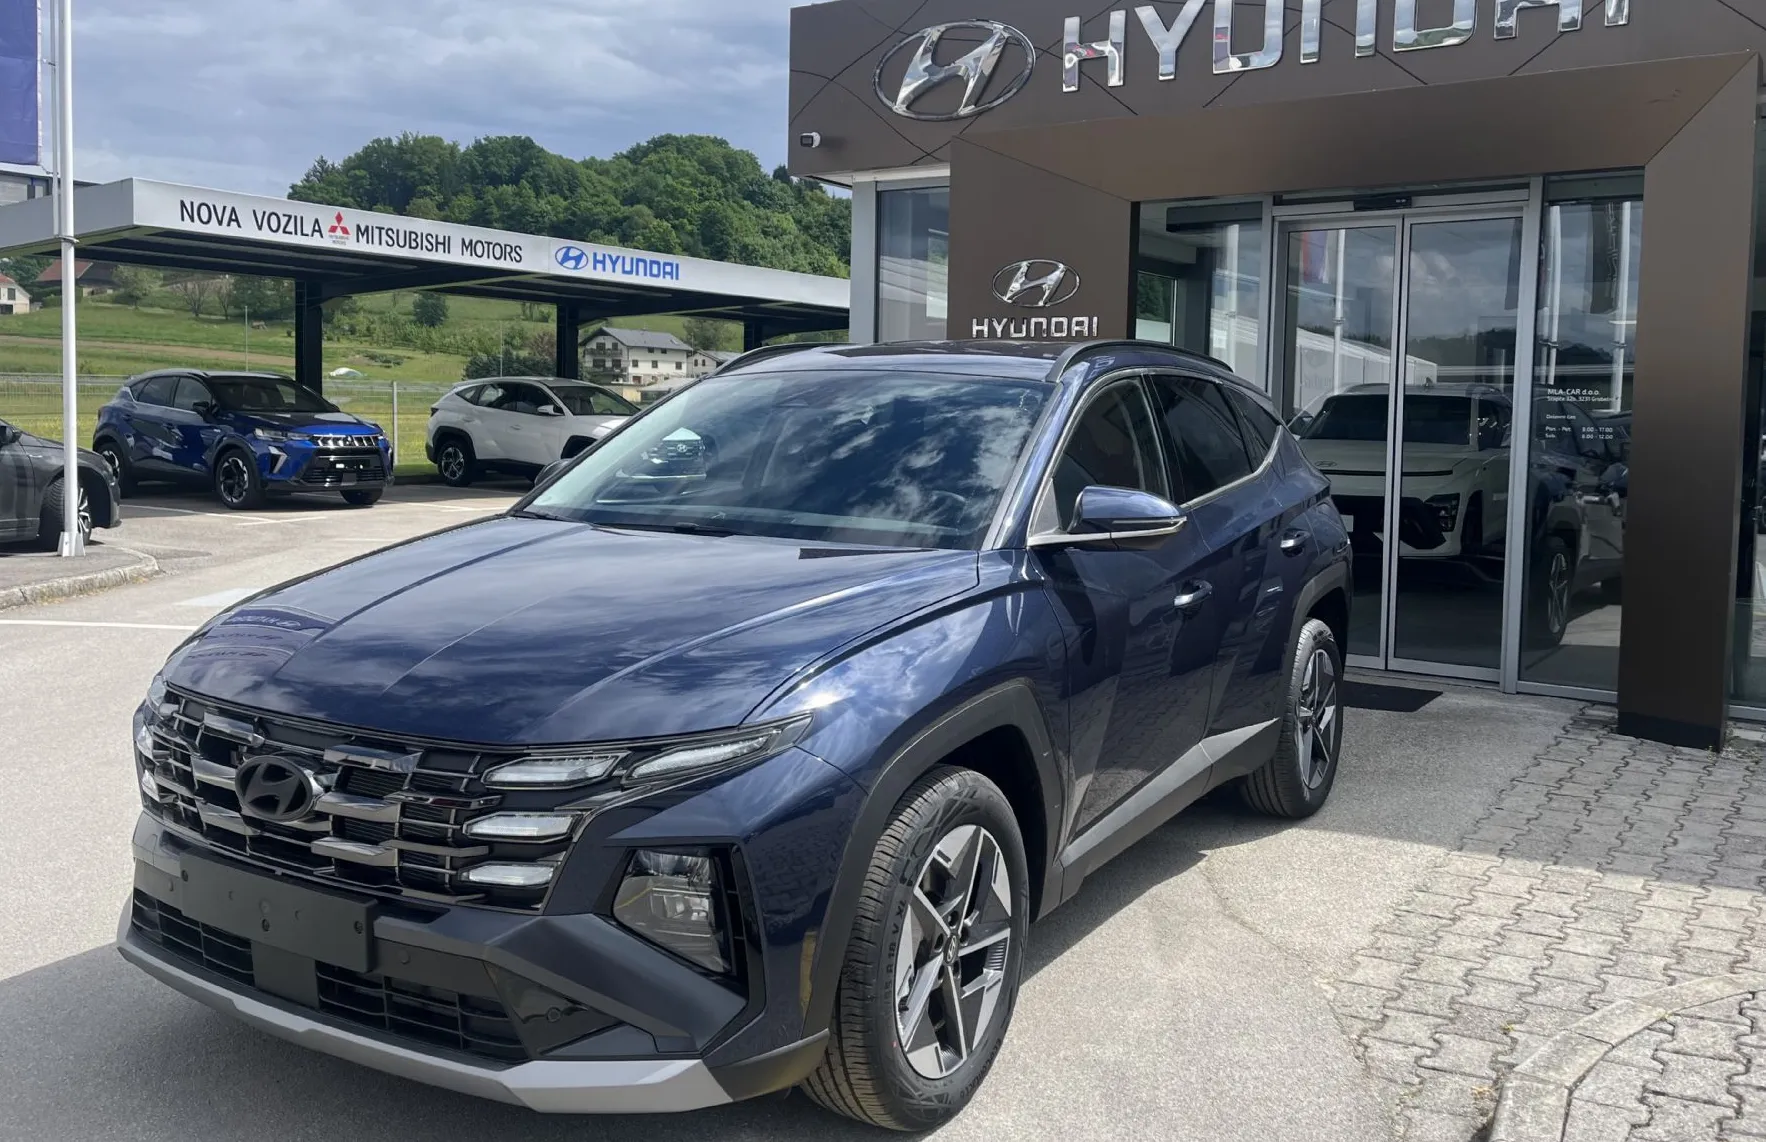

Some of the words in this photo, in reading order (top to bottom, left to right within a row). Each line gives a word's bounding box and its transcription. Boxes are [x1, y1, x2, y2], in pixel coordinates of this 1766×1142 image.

[179, 199, 242, 229] NOVA
[252, 208, 324, 239] VOZILA
[355, 223, 451, 255] MITSUBISHI
[461, 237, 523, 264] MOTORS
[592, 251, 680, 282] HYUNDAI
[972, 315, 1099, 339] HYUNDAI
